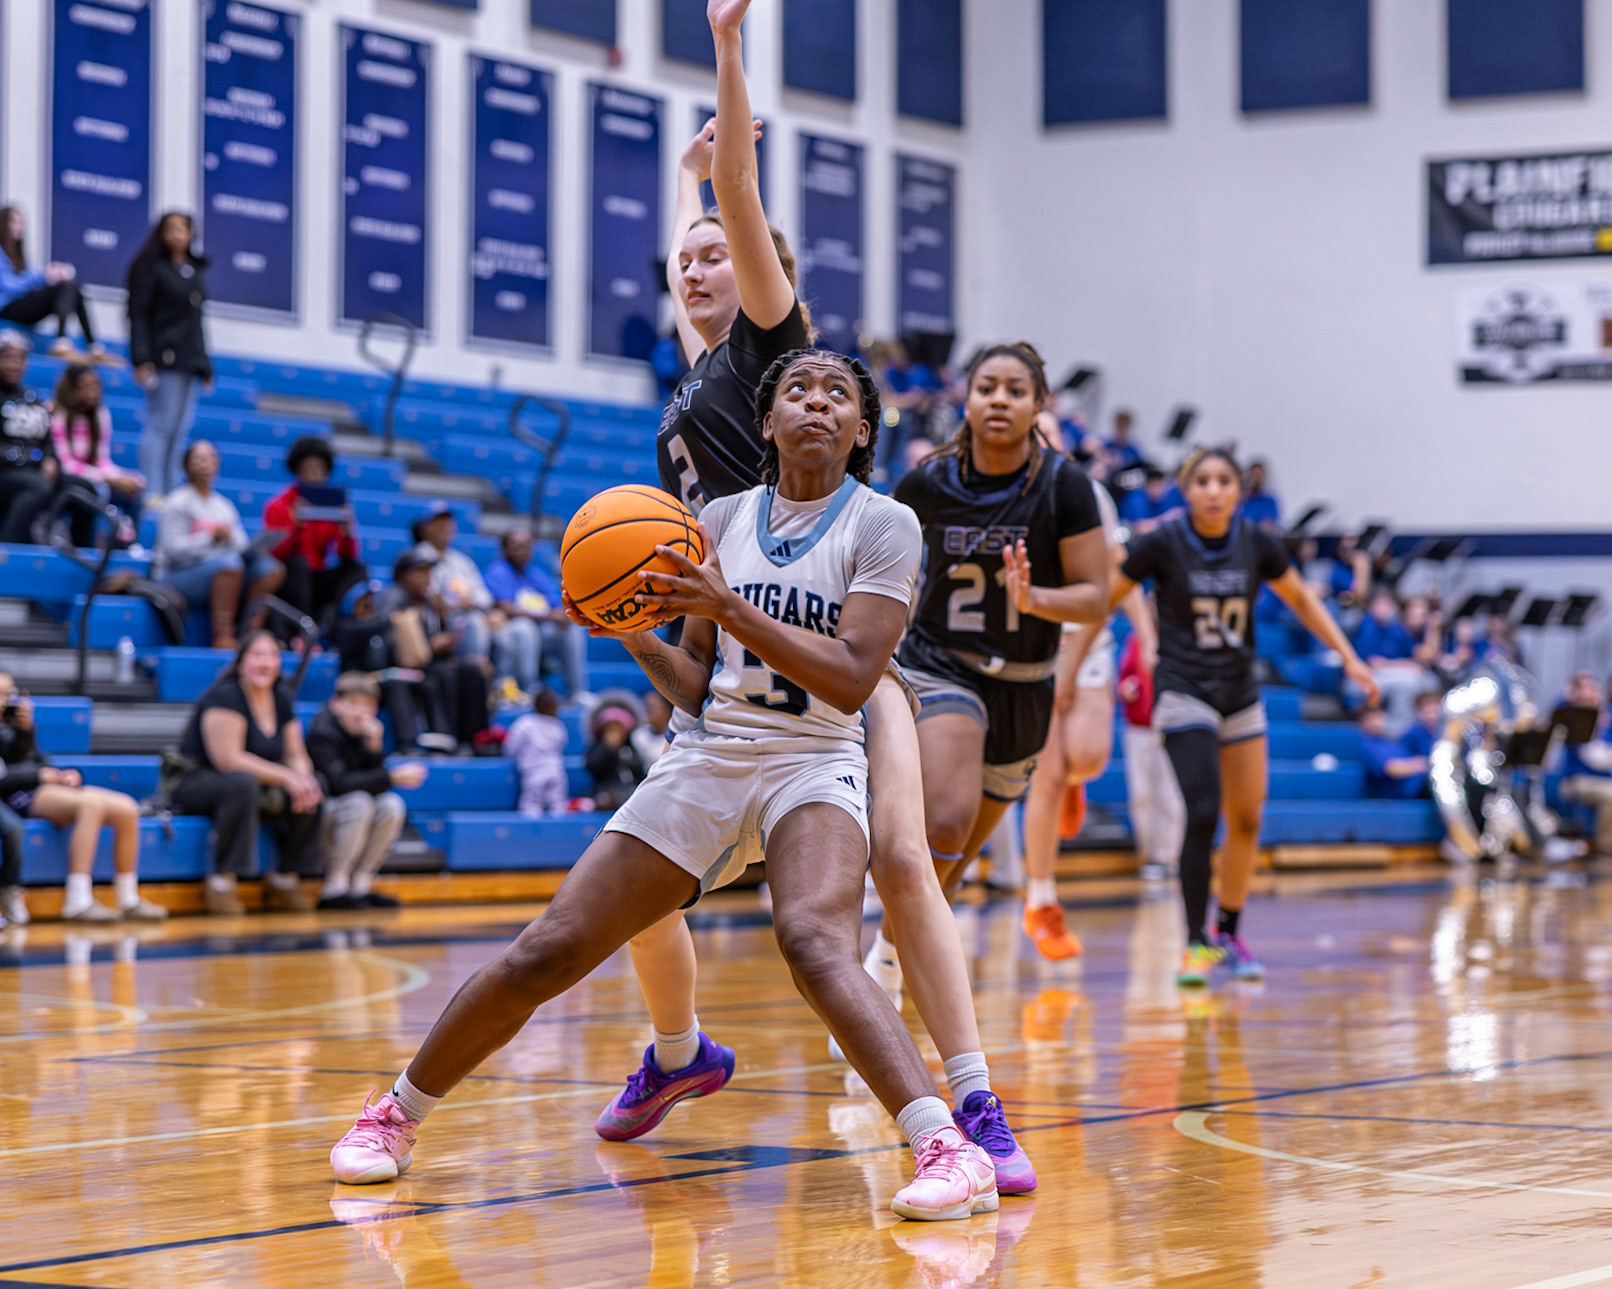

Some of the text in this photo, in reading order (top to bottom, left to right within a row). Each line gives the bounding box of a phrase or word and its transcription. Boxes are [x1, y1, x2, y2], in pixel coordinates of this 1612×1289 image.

[728, 582, 843, 639] UGARS
[947, 562, 1019, 632] 21
[1191, 596, 1249, 650] 20
